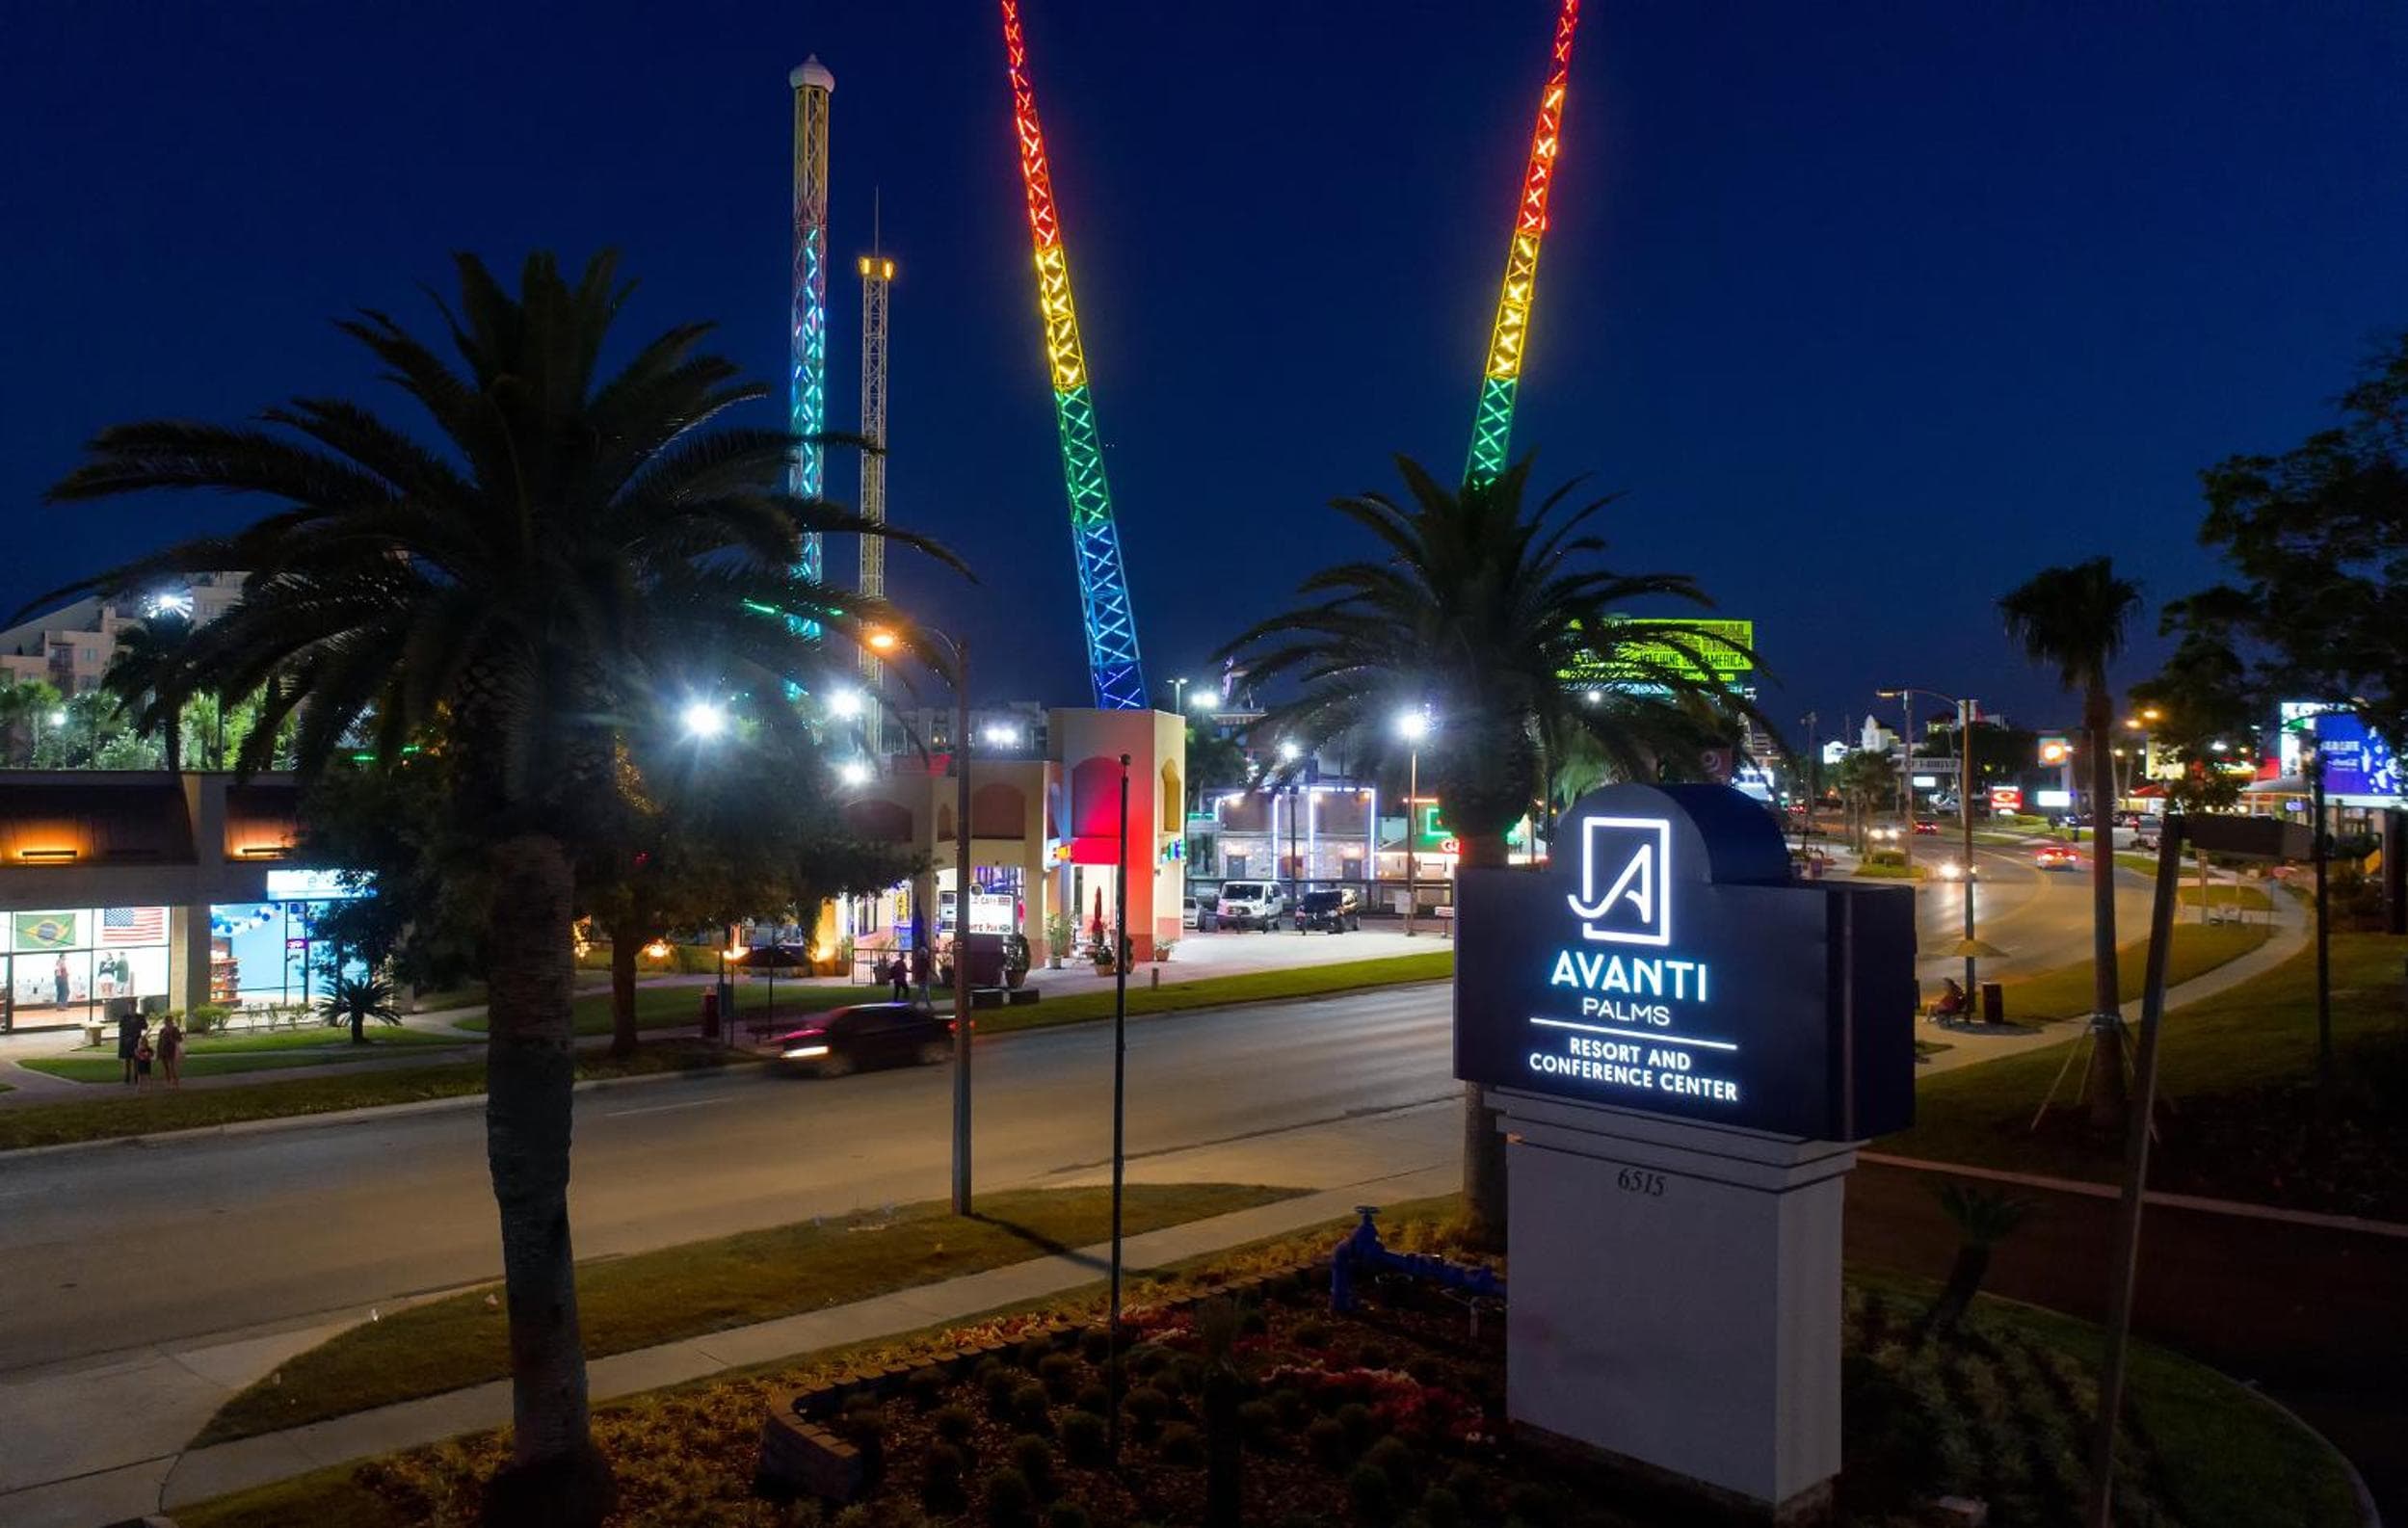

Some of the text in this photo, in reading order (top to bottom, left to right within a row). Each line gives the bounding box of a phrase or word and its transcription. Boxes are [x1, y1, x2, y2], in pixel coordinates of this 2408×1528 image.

[1550, 950, 1707, 1002] AVANTI
[1582, 997, 1670, 1026] PALMS
[1570, 1037, 1691, 1070] RESORT AND
[1529, 1053, 1737, 1101] CONFERENCE CENTER
[1618, 1168, 1666, 1197] 6515
